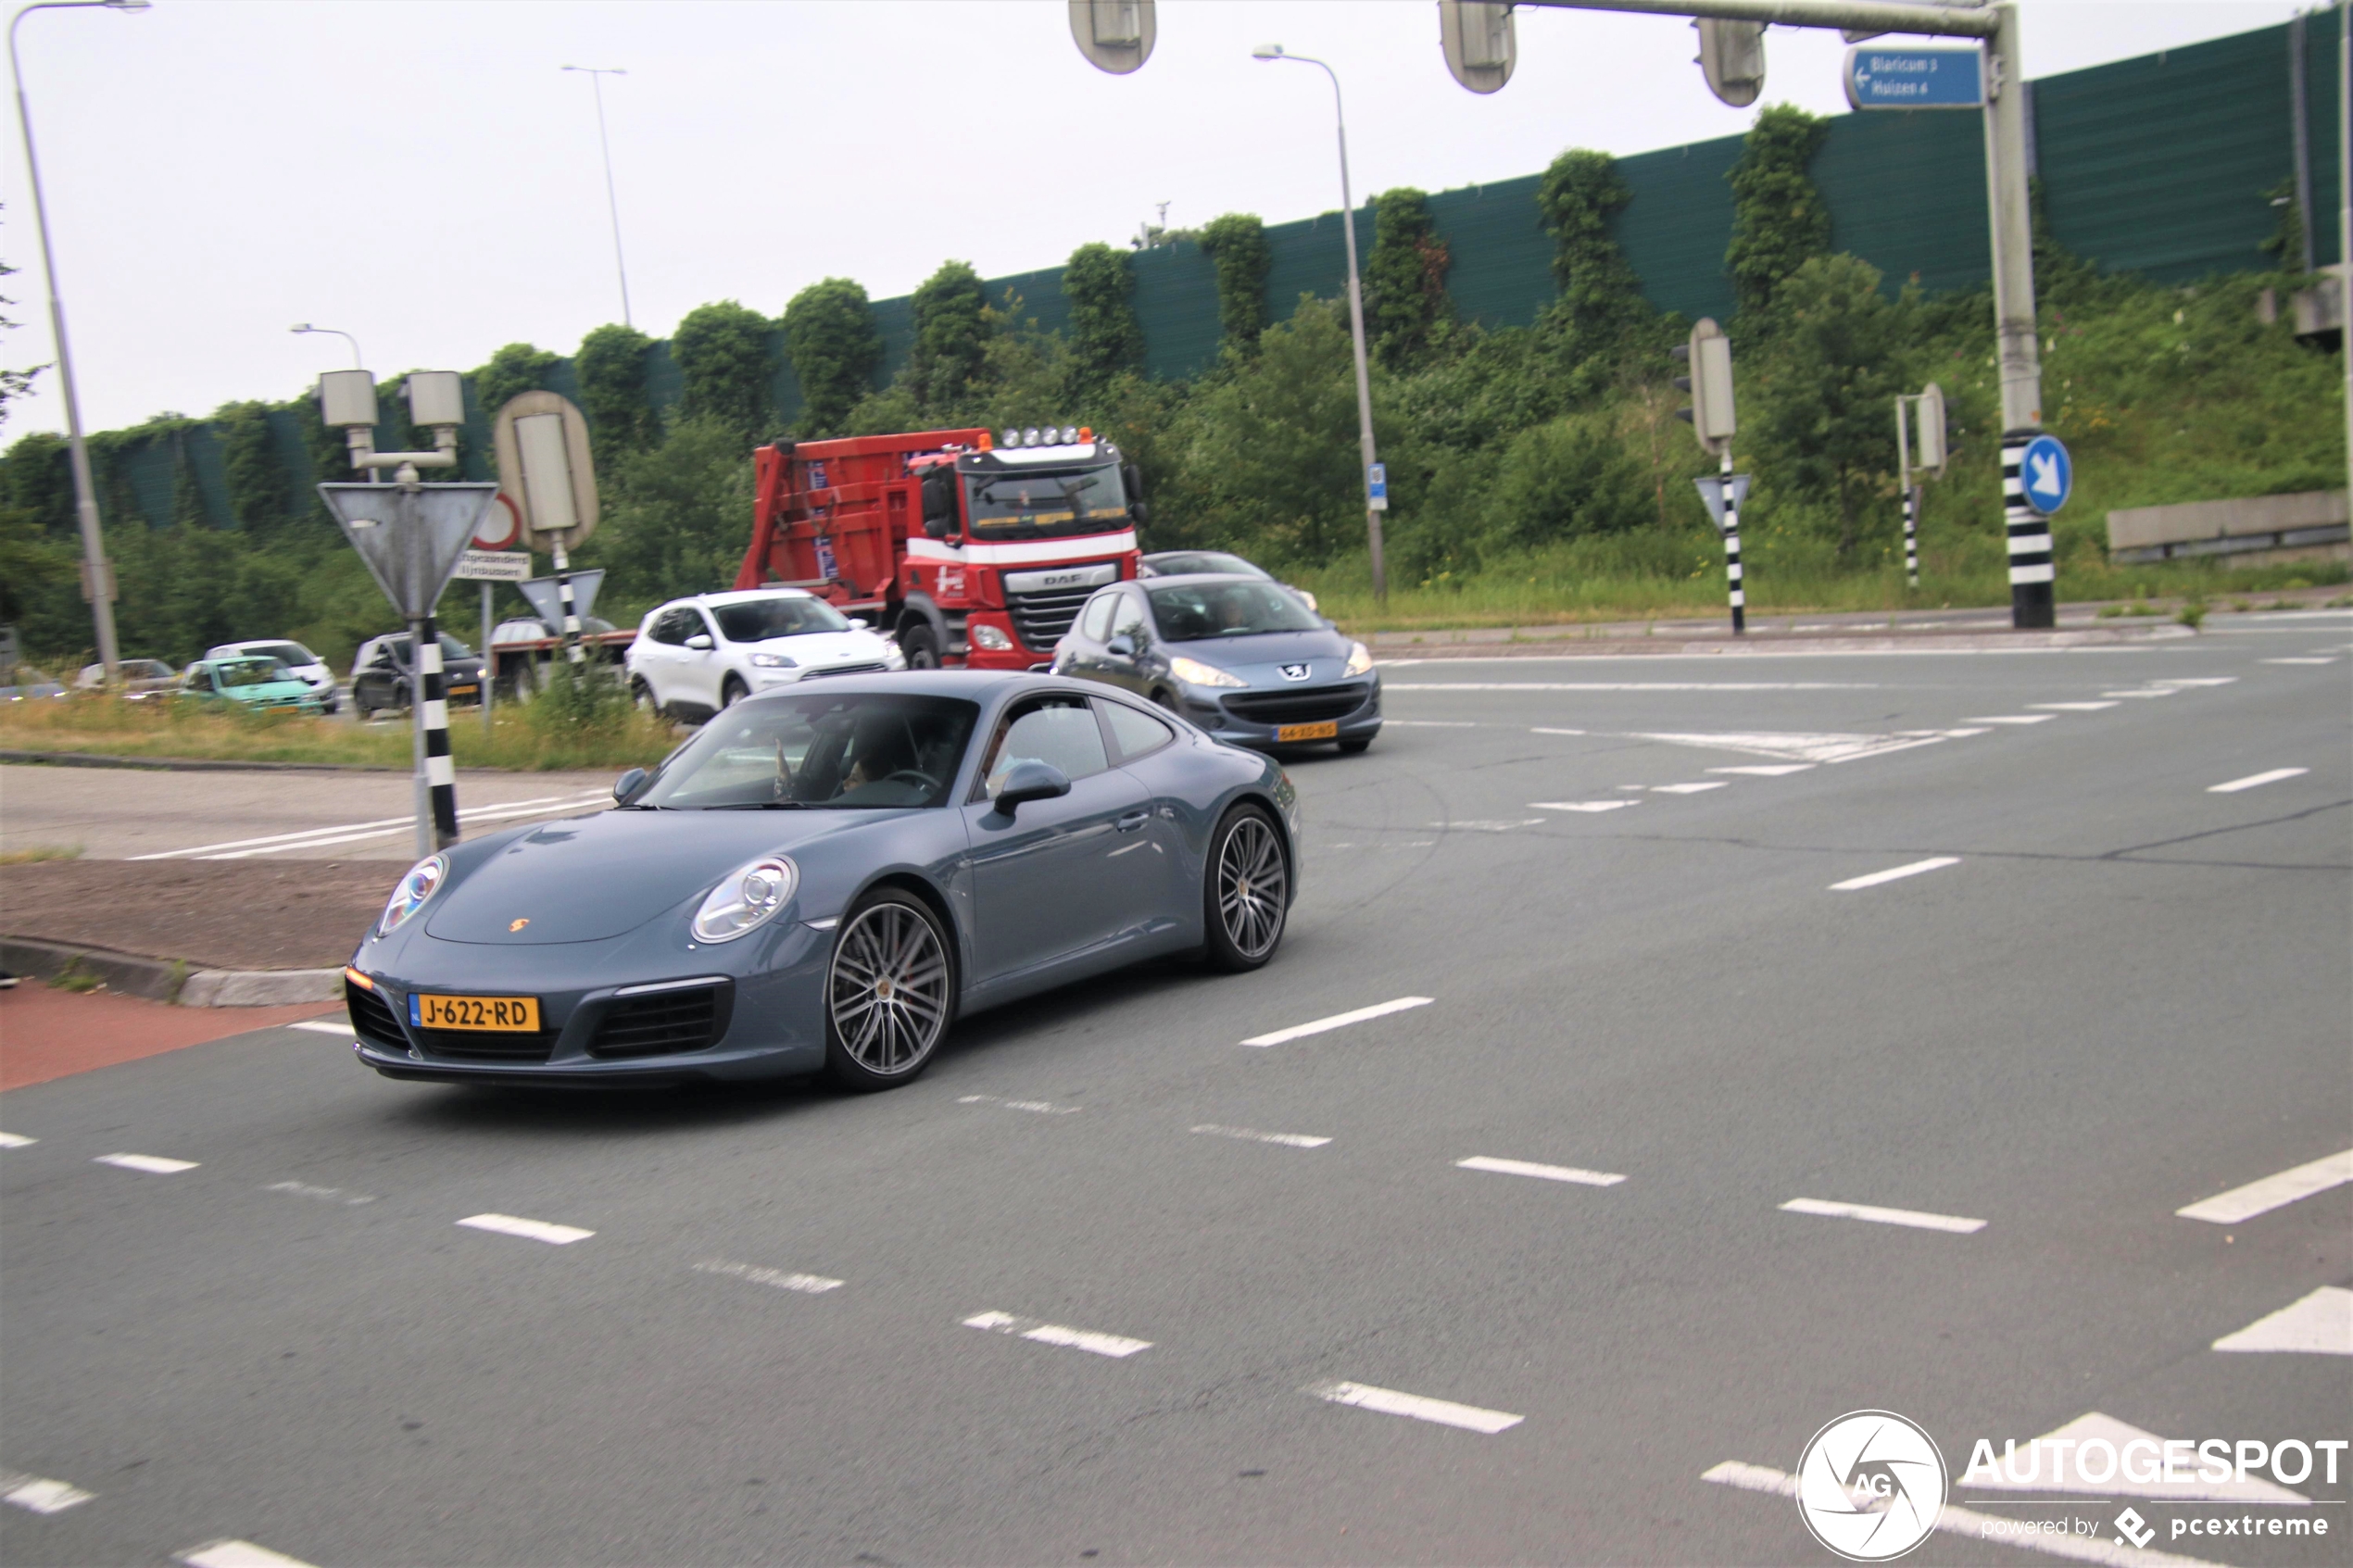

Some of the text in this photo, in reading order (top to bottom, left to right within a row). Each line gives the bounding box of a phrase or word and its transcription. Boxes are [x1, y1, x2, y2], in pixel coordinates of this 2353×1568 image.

[1870, 56, 1928, 73] Blaricum
[1871, 80, 1917, 95] Huizen
[1044, 574, 1081, 584] DAF
[426, 999, 527, 1025] J-622-RD
